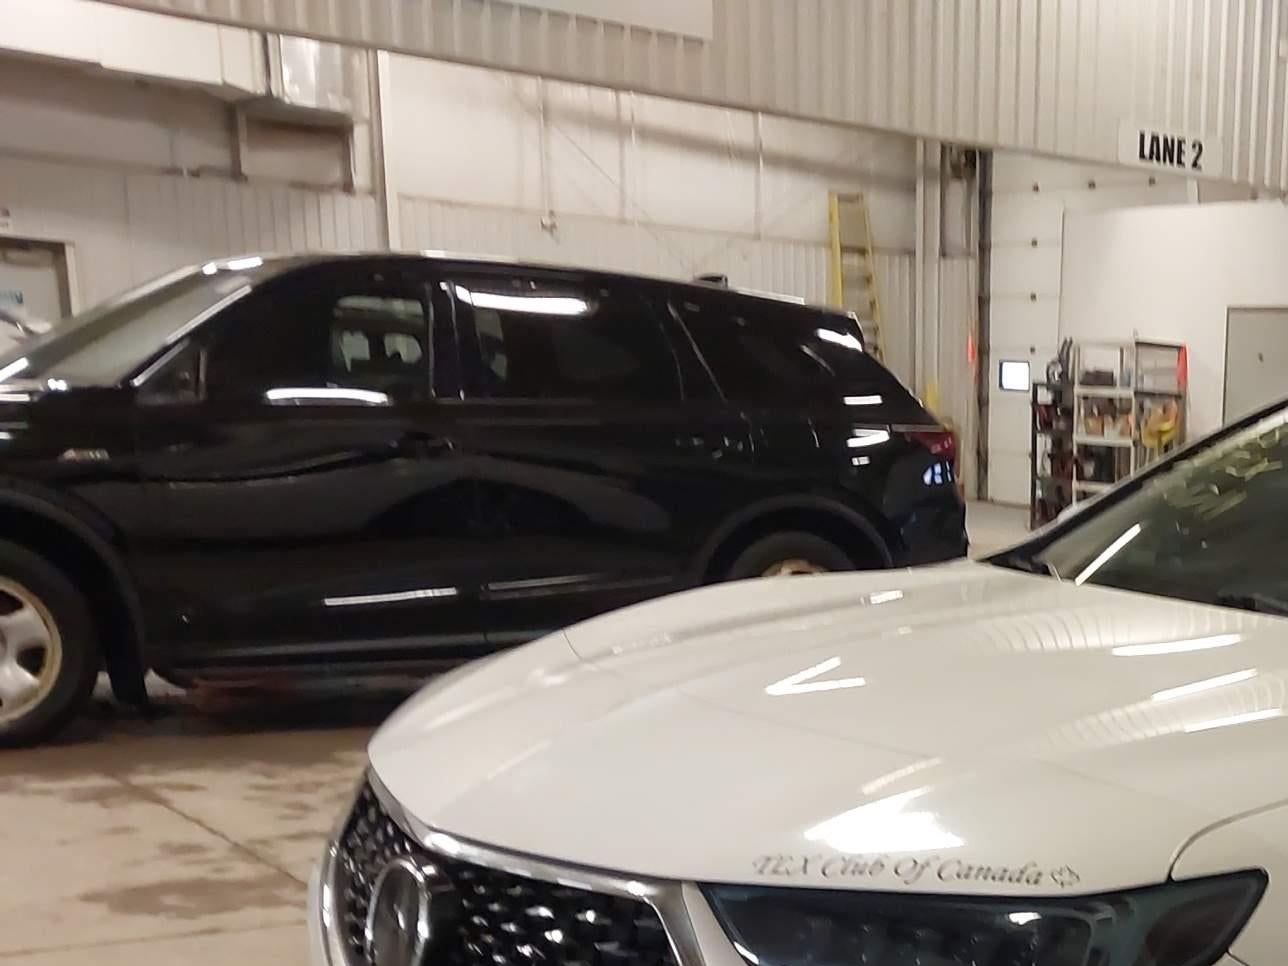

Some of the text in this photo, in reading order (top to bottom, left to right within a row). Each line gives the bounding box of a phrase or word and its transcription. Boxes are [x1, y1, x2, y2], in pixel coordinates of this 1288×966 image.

[1138, 131, 1204, 171] LANE 2
[821, 854, 888, 879] Club
[893, 855, 940, 886] Of
[936, 859, 1043, 886] Canada
